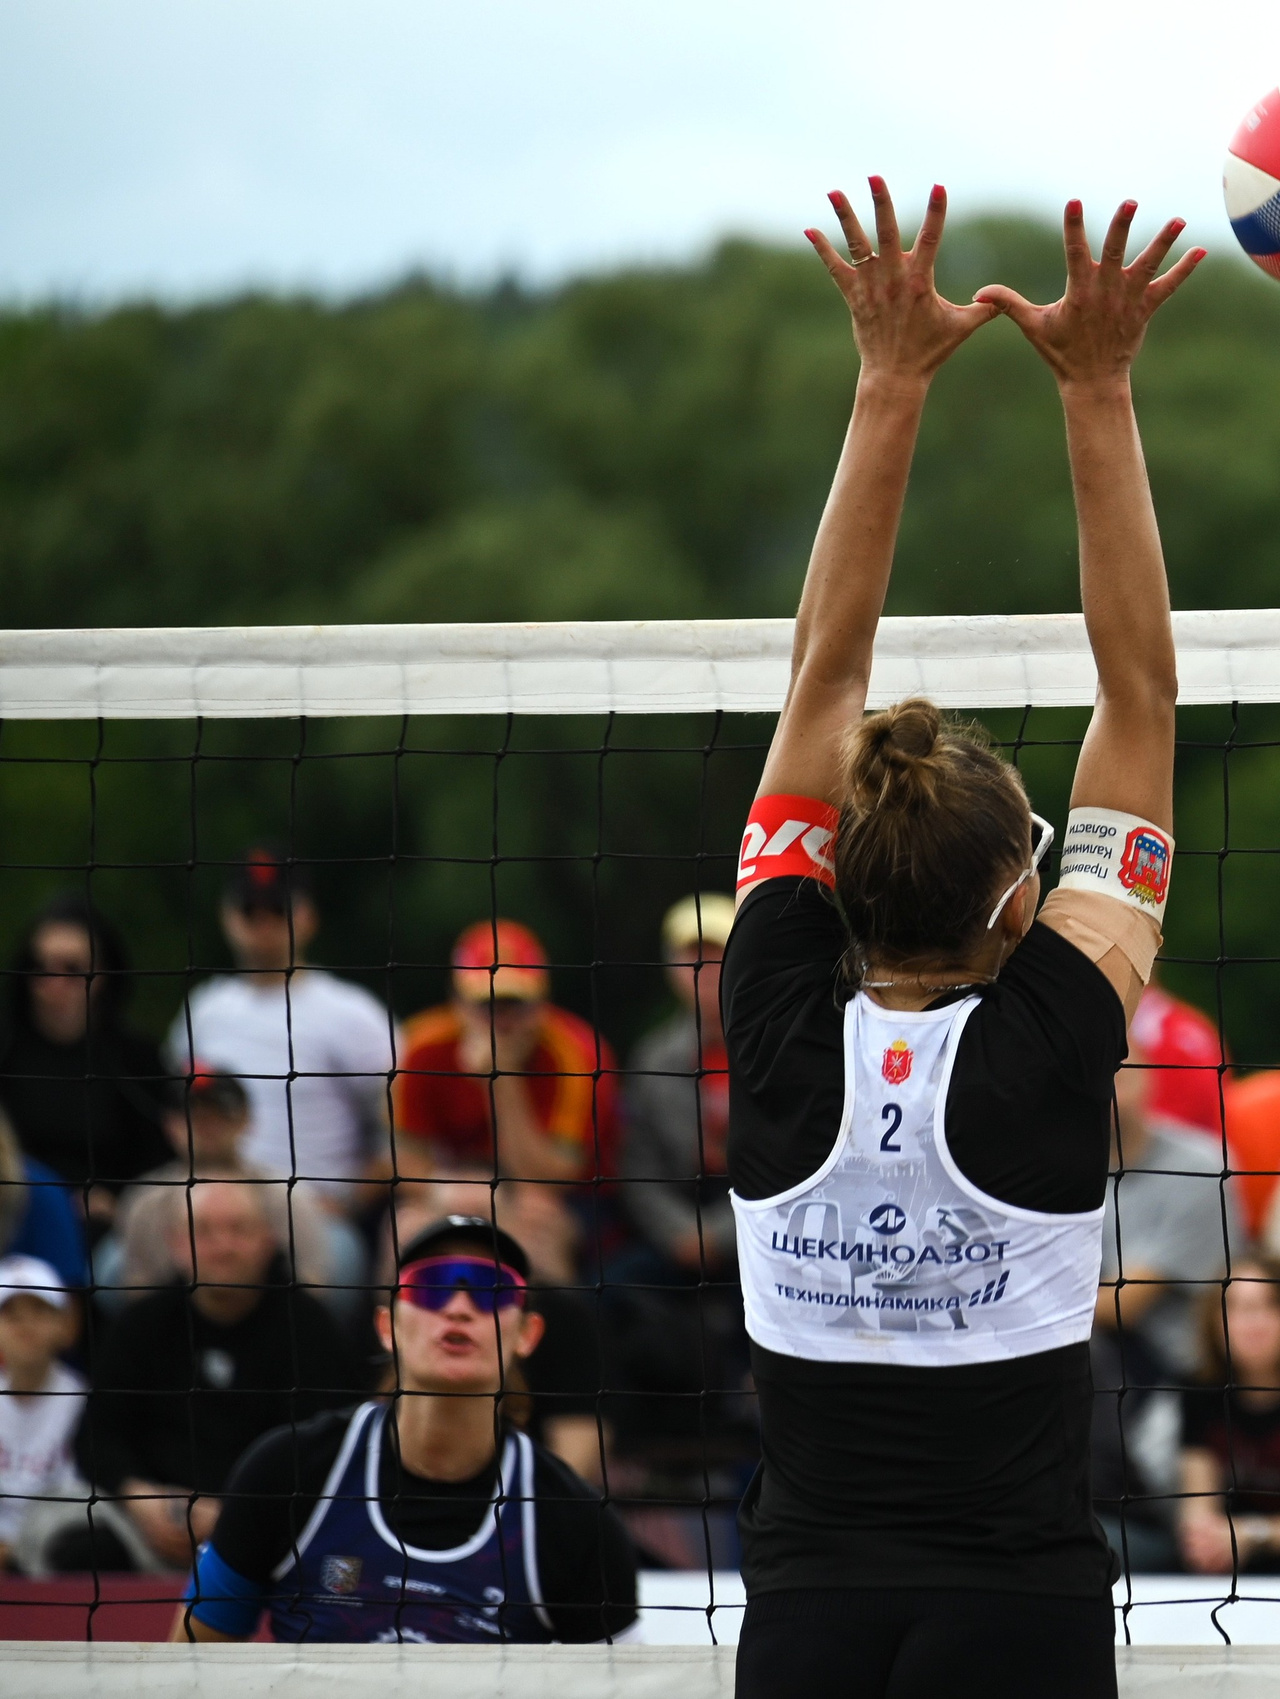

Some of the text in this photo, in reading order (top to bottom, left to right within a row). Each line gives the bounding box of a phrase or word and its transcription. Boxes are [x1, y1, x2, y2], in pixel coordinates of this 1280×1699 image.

[1068, 823, 1117, 838] области
[879, 1102, 903, 1153] 2
[771, 1231, 1011, 1265] ЩЕКИНОАЗОТ
[774, 1282, 960, 1312] ТЕХНОДИНАМИКА
